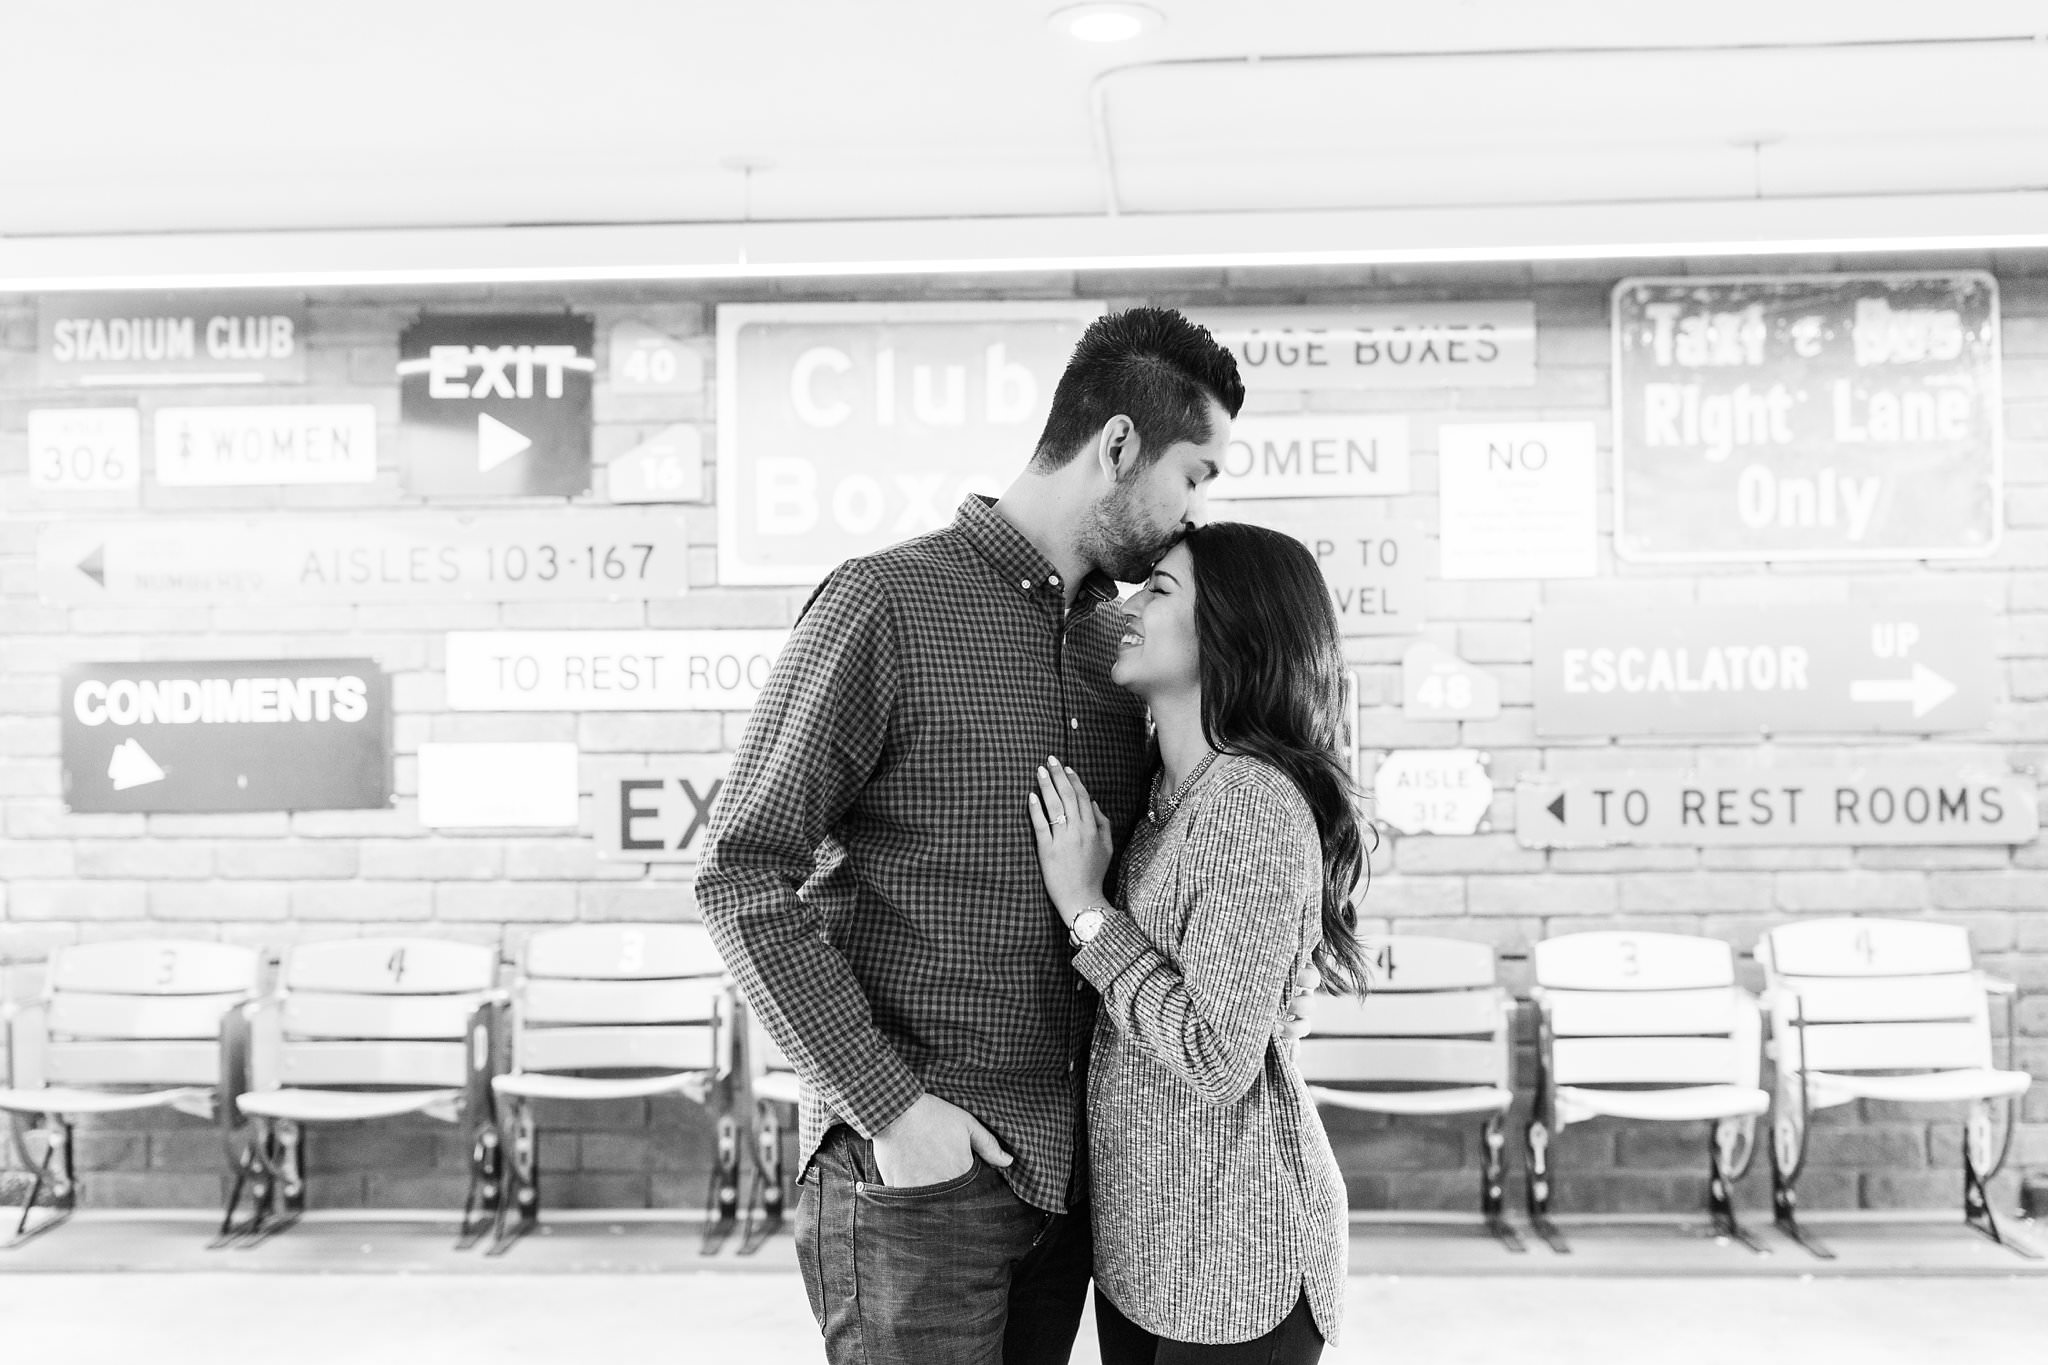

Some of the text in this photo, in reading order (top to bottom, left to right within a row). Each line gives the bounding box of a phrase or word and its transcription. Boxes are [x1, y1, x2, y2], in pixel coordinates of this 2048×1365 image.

[53, 315, 295, 361] STADIUM CLUB
[1241, 323, 1499, 367] OGE BOXES
[1646, 304, 1765, 367] Taxi
[1851, 300, 1964, 367] Bus
[427, 345, 578, 400] EXIT
[622, 348, 678, 384] 40
[790, 341, 1038, 429] Club
[1643, 378, 1972, 463] Right Lane
[42, 444, 125, 483] 306
[209, 424, 352, 464] WOMEN
[1223, 438, 1379, 479] OMEN
[1487, 439, 1549, 471] NO
[639, 456, 686, 491] 16
[755, 456, 1002, 536] Box
[1736, 462, 1882, 543] Only
[300, 546, 461, 585] AISLES
[1356, 537, 1399, 567] TO
[1333, 586, 1399, 616] VEL
[1870, 620, 1920, 659] UP
[491, 652, 773, 693] TO REST ROO
[1562, 645, 1810, 694] ESCALATOR
[73, 675, 368, 727] CONDIMENTS
[1415, 672, 1473, 710] 48
[1396, 768, 1471, 790] AISLE
[620, 779, 725, 851] EX
[1412, 799, 1460, 823] 312
[1591, 784, 2006, 828] TO REST ROOMS
[156, 948, 178, 986] 3
[386, 946, 407, 984] 4
[616, 928, 647, 974] 3
[1376, 944, 1397, 980] 4
[1617, 939, 1641, 977] 3
